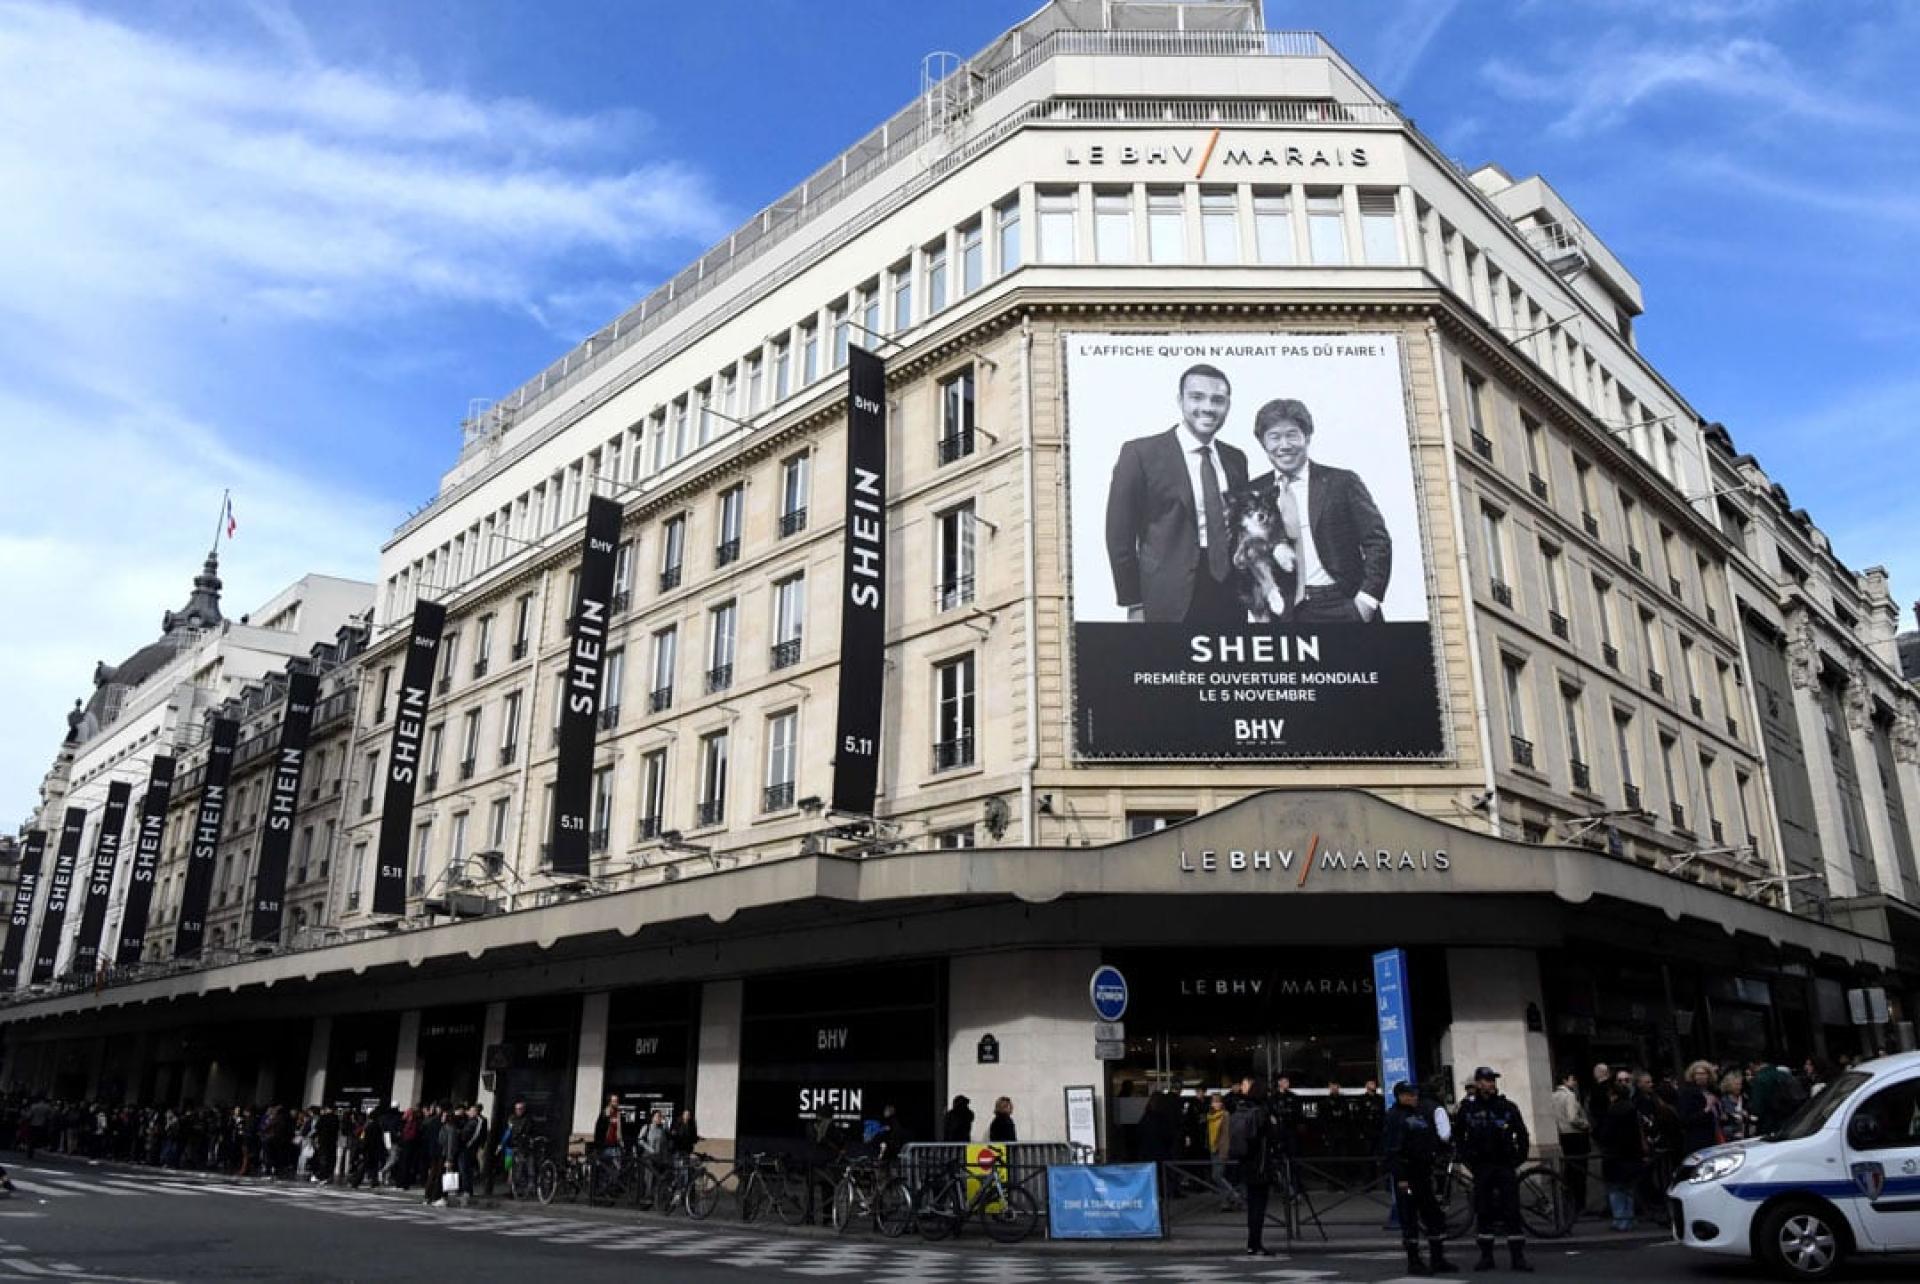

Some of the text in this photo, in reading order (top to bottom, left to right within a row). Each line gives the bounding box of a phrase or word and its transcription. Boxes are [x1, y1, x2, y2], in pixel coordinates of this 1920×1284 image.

[1066, 146, 1104, 165] LE
[1120, 146, 1194, 165] BHV
[1222, 146, 1369, 167] MARAIS
[1080, 344, 1154, 357] L'AFFICHE
[1158, 345, 1206, 358] QU'ON
[1210, 345, 1276, 357] N'AURAIT
[1281, 345, 1309, 357] PAS
[1336, 346, 1376, 357] FAIRE
[854, 396, 880, 413] BHV
[589, 538, 614, 554] BHV
[852, 467, 881, 610] SHEIN
[570, 600, 606, 715] SHEIN
[1190, 635, 1320, 662] SHEIN
[1134, 670, 1379, 685] PREMIÈRE OUVERTURE MONDIALE
[1199, 690, 1317, 702] LE 5 NOVEMBRE
[393, 687, 426, 784] SHEIN
[1235, 719, 1285, 740] BHV
[844, 735, 873, 756] 5.11
[271, 748, 302, 832] SHEIN
[195, 785, 225, 860] SHEIN
[561, 815, 585, 831] 5.11
[135, 815, 162, 882] SHEIN
[91, 833, 118, 896] SHEIN
[1180, 849, 1217, 870] LE
[1229, 849, 1294, 870] BHV
[1321, 849, 1450, 870] MARAIS
[383, 864, 402, 878] 5.11
[50, 855, 73, 912] SHEIN
[13, 874, 35, 926] SHEIN
[1181, 979, 1207, 996] LE
[1215, 978, 1263, 995] BHV
[1281, 976, 1374, 995] MARAIS
[635, 1038, 659, 1055] BHV
[817, 1027, 850, 1051] BHV
[799, 1088, 863, 1111] SHEIN
